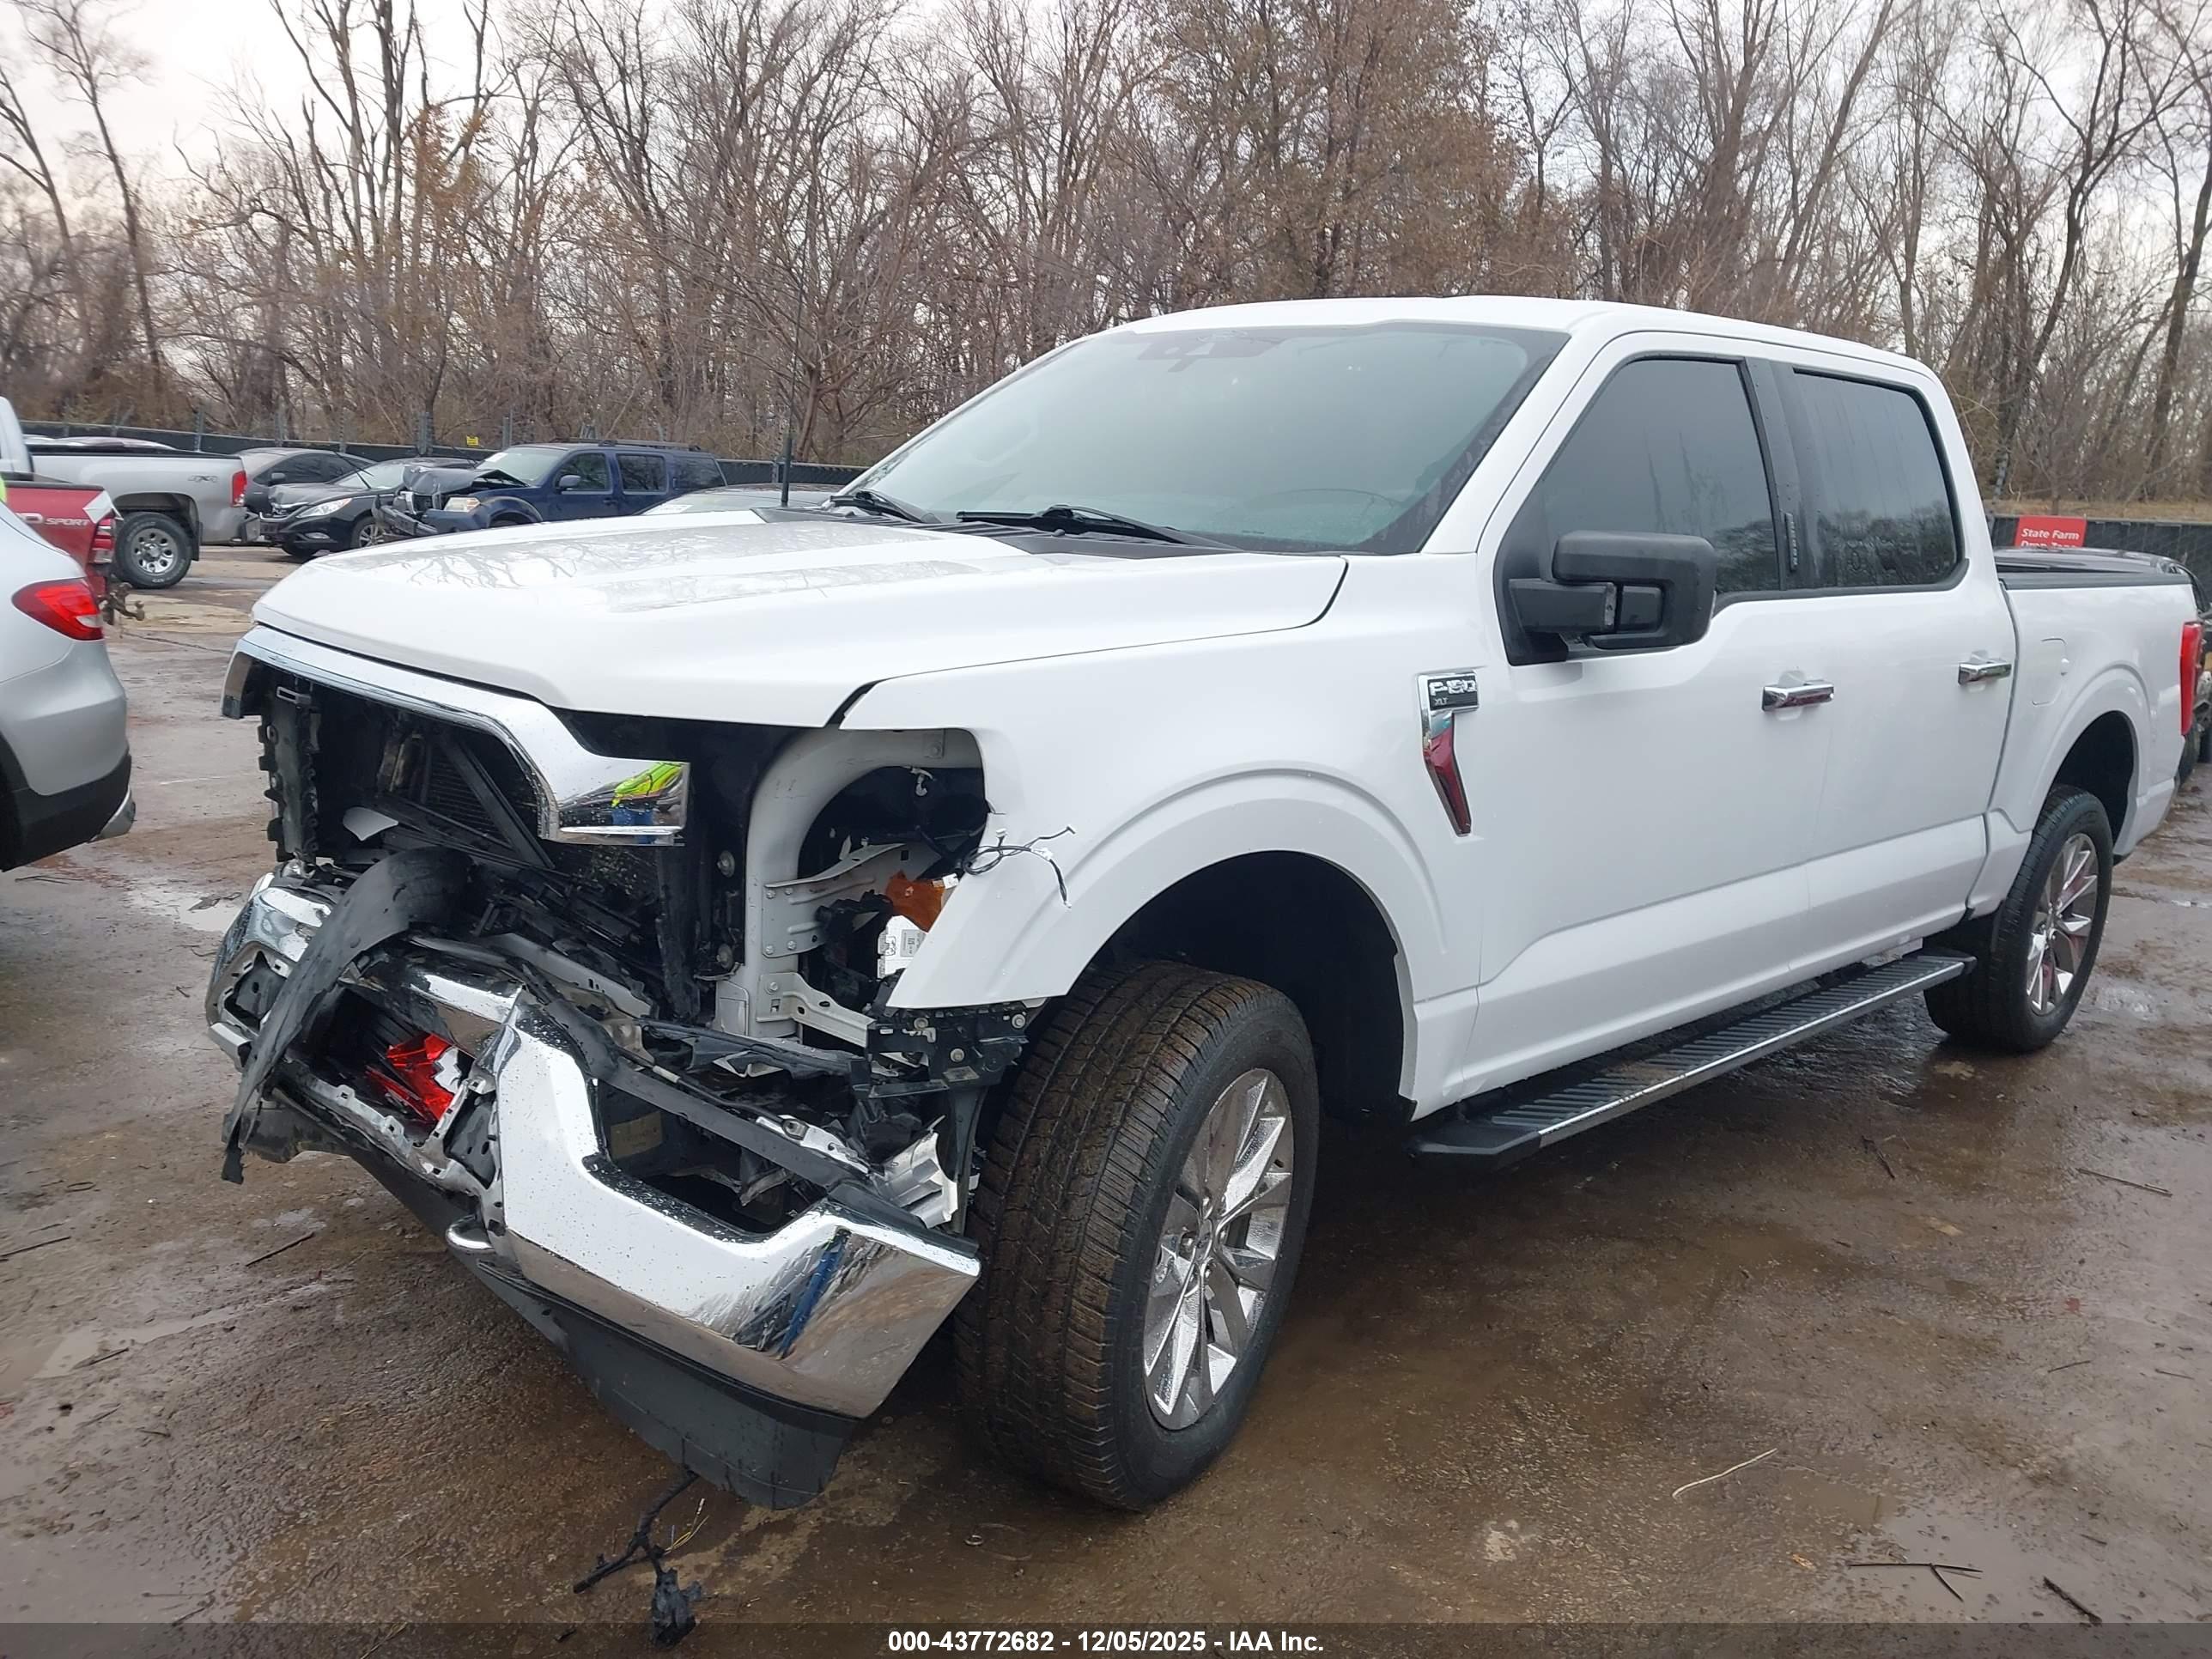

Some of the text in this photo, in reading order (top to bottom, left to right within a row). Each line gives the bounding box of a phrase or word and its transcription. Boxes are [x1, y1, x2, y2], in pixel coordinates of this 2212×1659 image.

[46, 518, 89, 526] SPORT
[2021, 528, 2080, 540] State Farm
[1434, 697, 1448, 706] XLT
